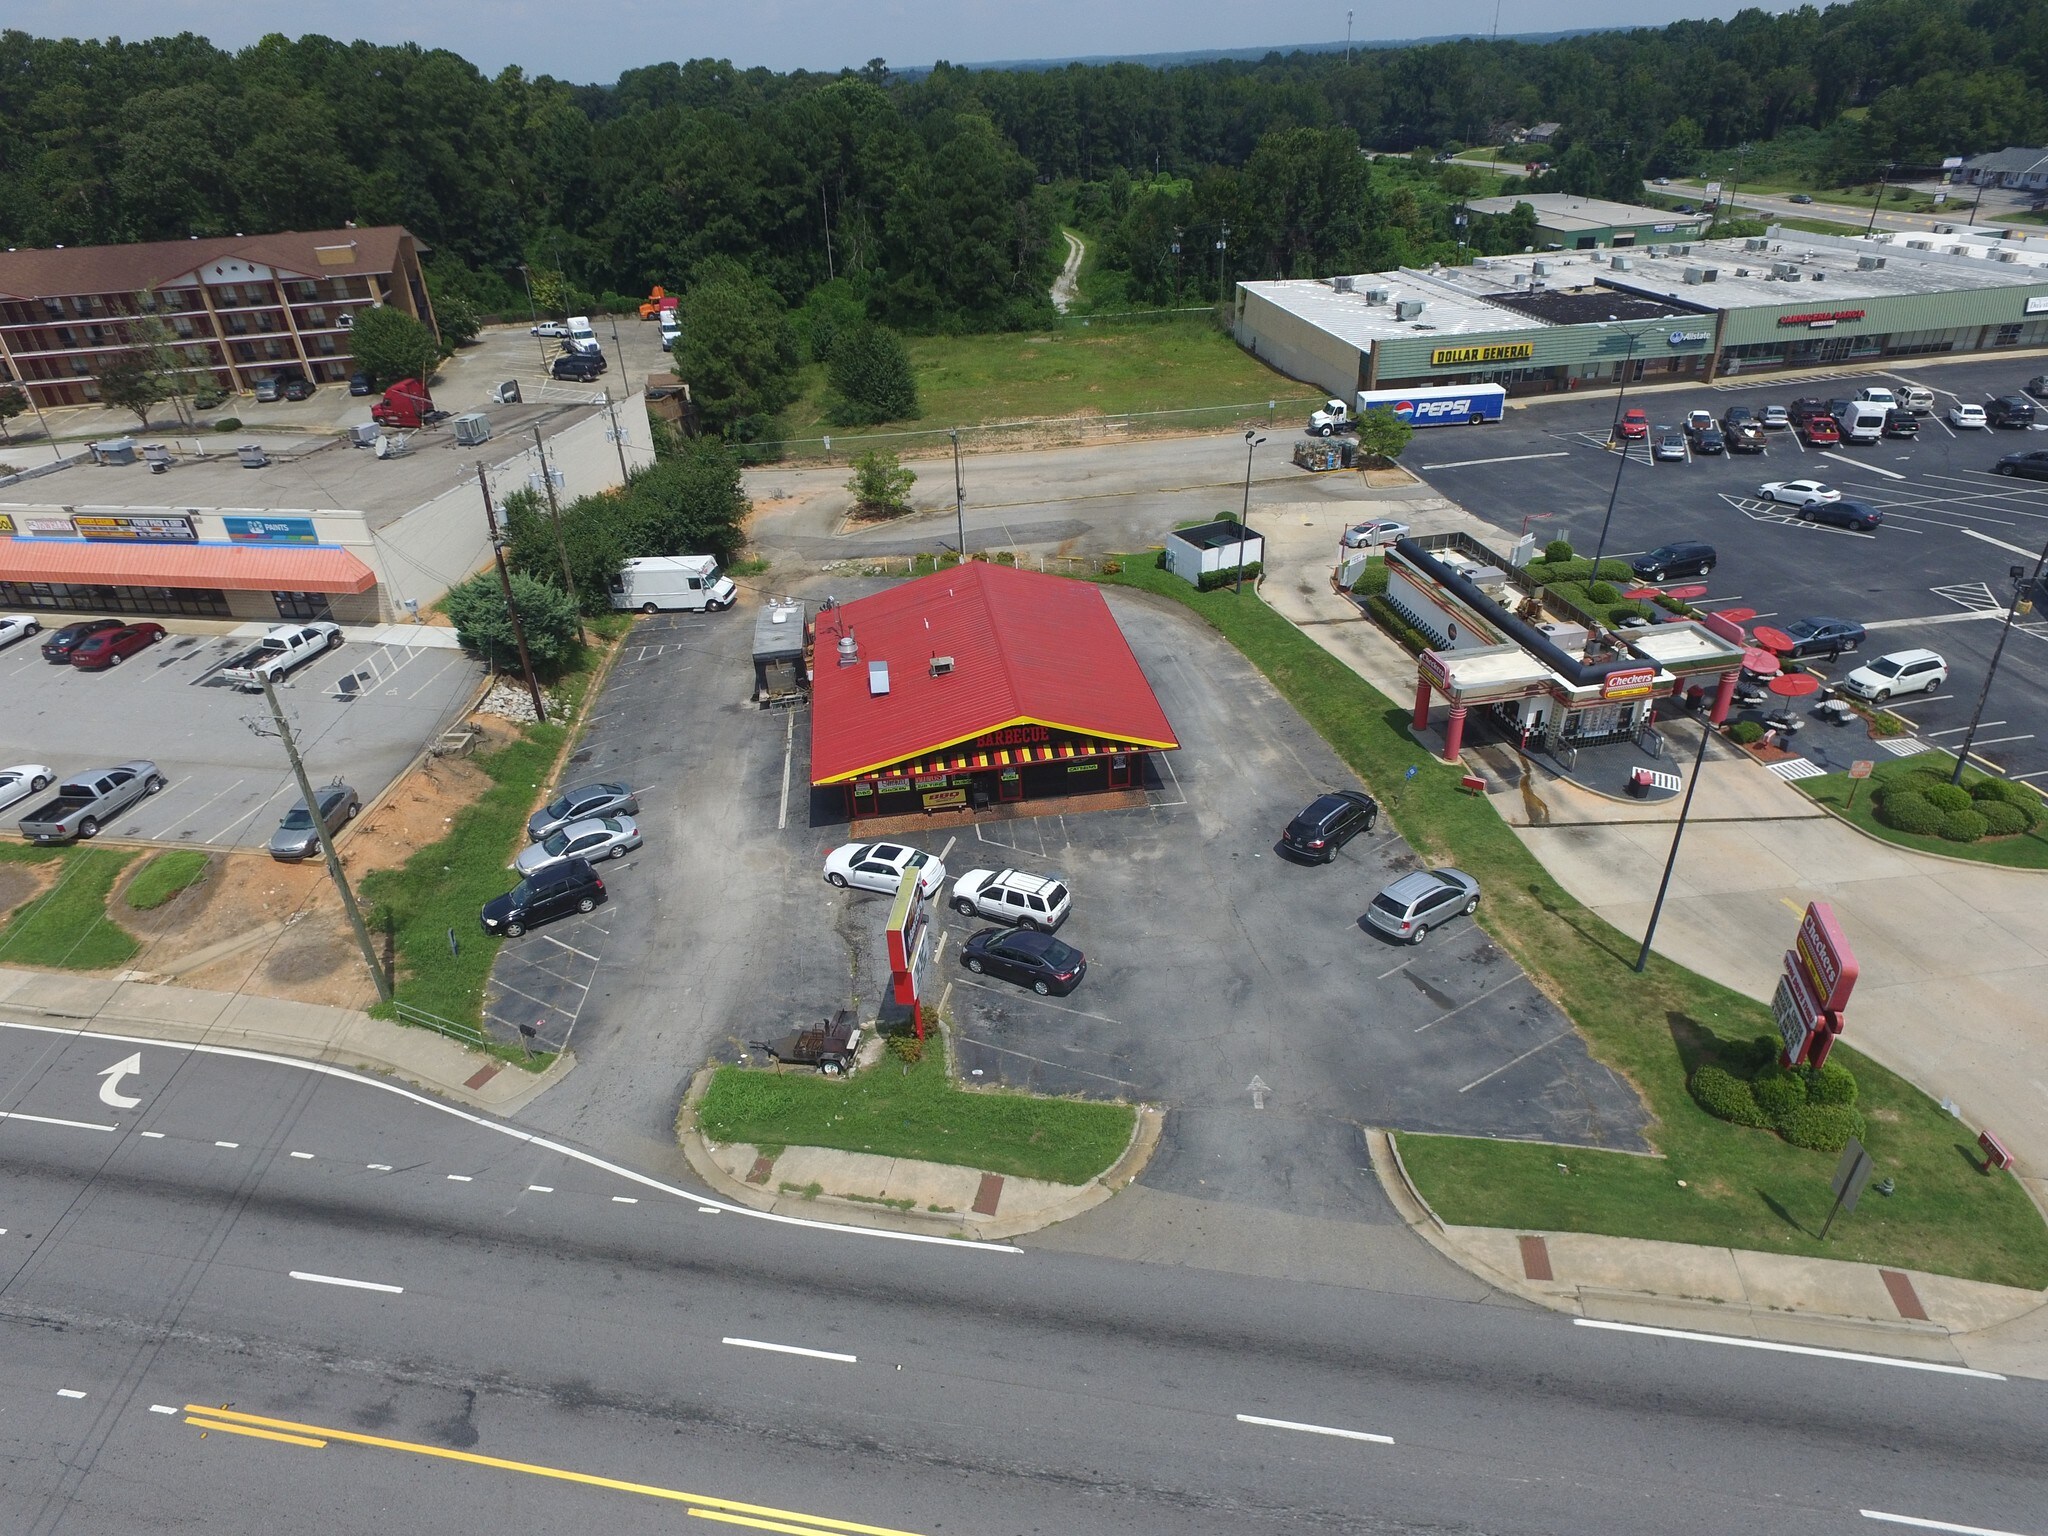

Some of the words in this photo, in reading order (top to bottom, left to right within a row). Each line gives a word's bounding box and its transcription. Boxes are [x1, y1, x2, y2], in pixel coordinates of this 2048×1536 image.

[1683, 332, 1711, 340] Allstate
[1437, 349, 1479, 362] DOLLAR
[1482, 344, 1530, 360] GENERAL
[1415, 400, 1471, 418] PEPSI
[264, 524, 289, 532] PAINTS
[1423, 654, 1445, 677] Checkers
[1609, 674, 1653, 686] Checkers
[976, 726, 1050, 748] BARBECUE
[929, 792, 960, 800] BBQ
[1804, 914, 1836, 983] Checkers
[1792, 977, 1804, 1001] DRIVE
